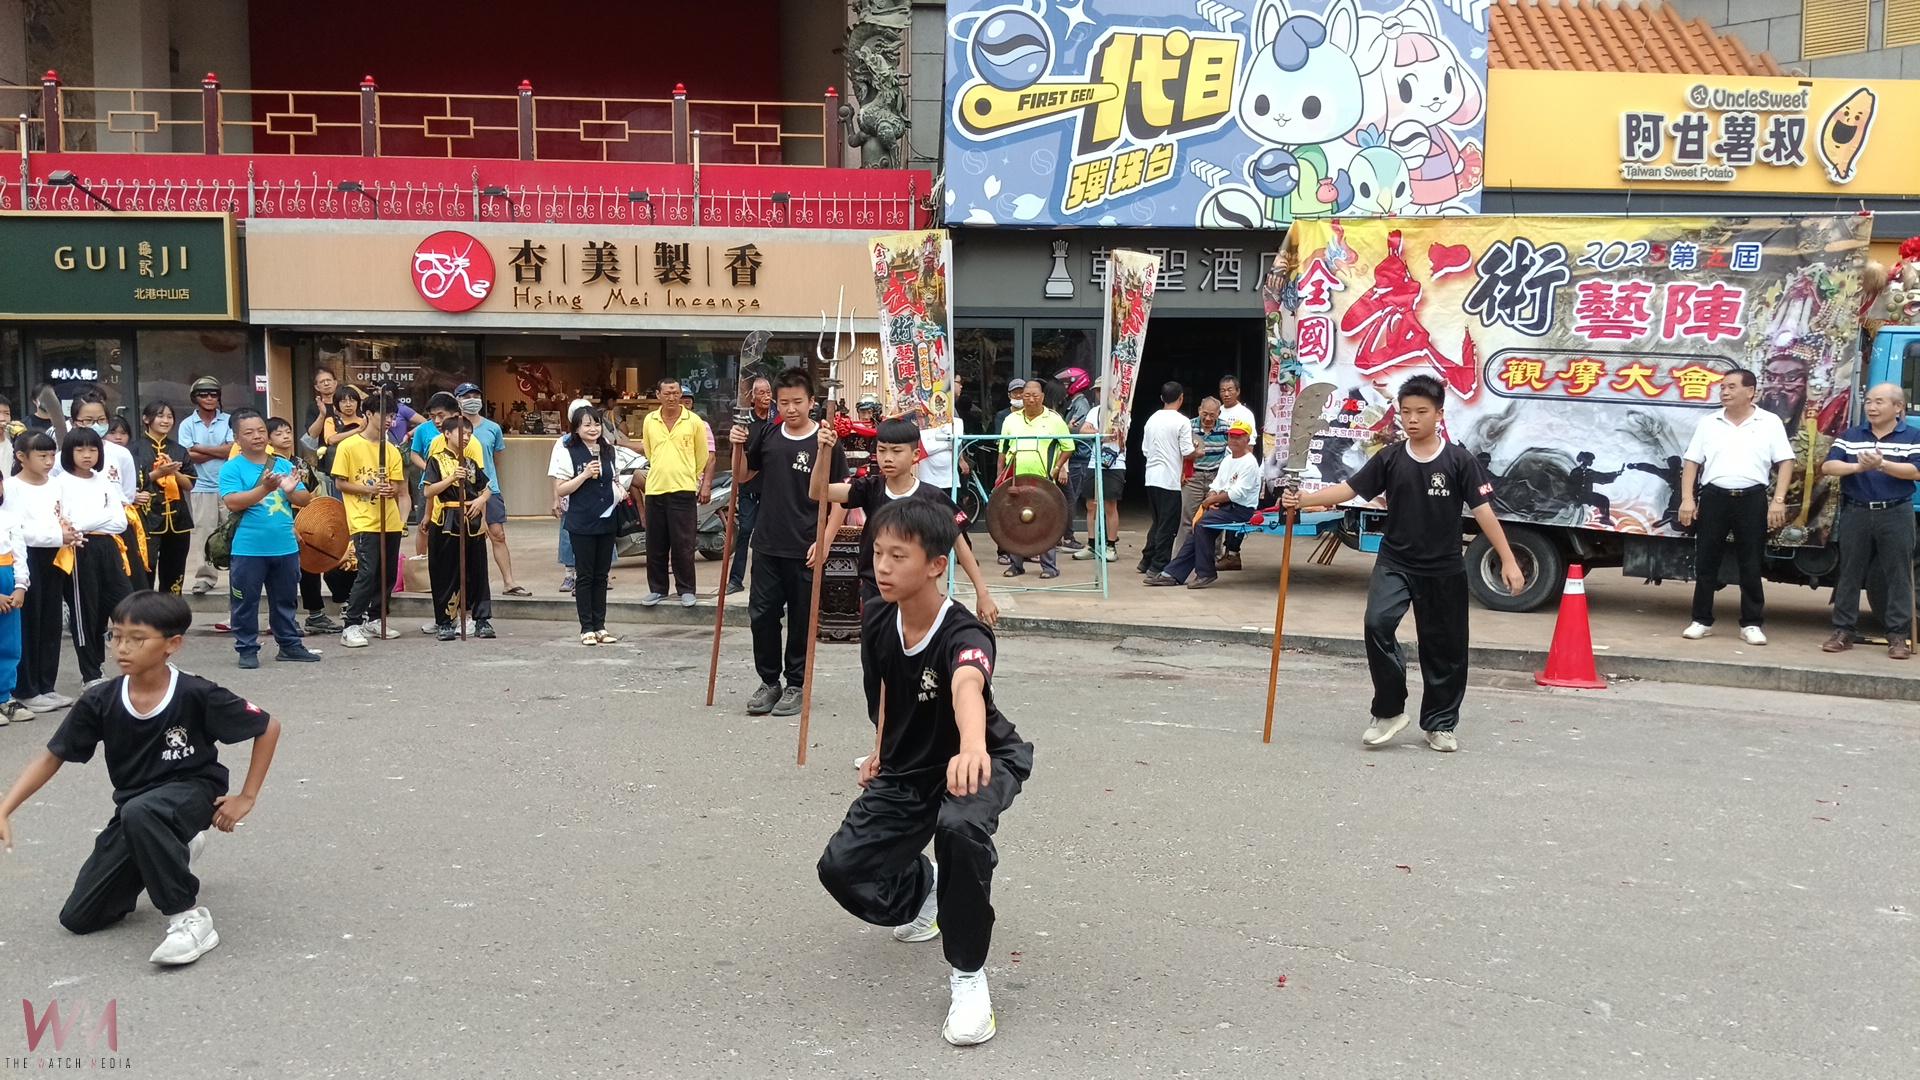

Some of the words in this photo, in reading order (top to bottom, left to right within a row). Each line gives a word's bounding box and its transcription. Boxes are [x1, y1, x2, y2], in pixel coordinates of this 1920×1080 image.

[1017, 90, 1068, 112] FIRST
[1070, 87, 1095, 104] GEN
[1712, 87, 1809, 110] UncleSweet
[1625, 112, 1808, 164] 阿甘薯叔
[1065, 144, 1175, 211] 彈珠台
[1624, 165, 1662, 178] Taiwan
[1664, 166, 1698, 178] Sweet
[1699, 167, 1734, 179] Potato
[54, 246, 126, 270] GUI
[160, 246, 187, 276] JI
[134, 287, 190, 300] 北港中山店
[513, 286, 583, 310] Hsing
[603, 288, 649, 310] Mei
[667, 288, 761, 312] Incense
[1297, 258, 1343, 364] 全國
[1573, 280, 1746, 342] 藝陣
[356, 373, 385, 381] OPEN
[387, 373, 414, 381] TIME
[1501, 358, 1725, 400] 觀摩大會
